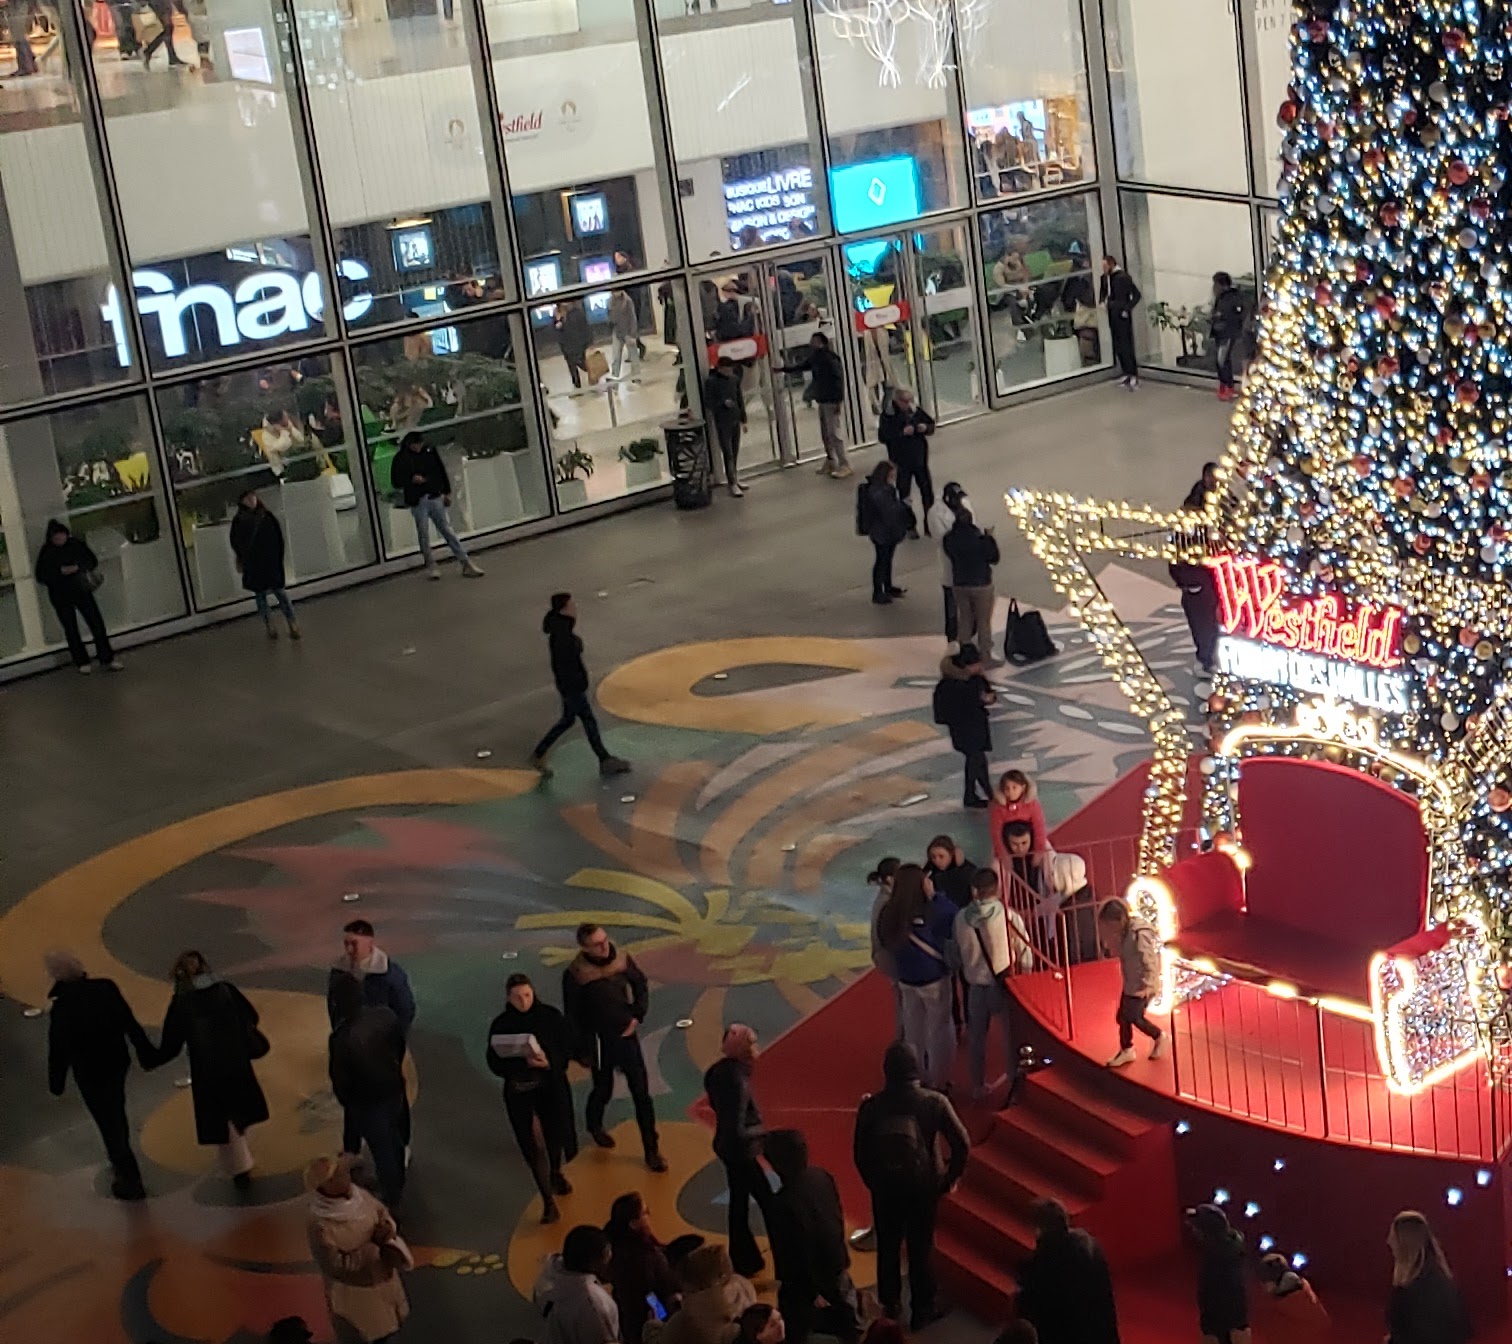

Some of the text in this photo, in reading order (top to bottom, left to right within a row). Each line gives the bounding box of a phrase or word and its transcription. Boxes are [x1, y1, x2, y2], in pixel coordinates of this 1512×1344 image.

[766, 168, 813, 194] LIVRE
[101, 258, 373, 367] fnac
[1203, 555, 1402, 668] Westfield
